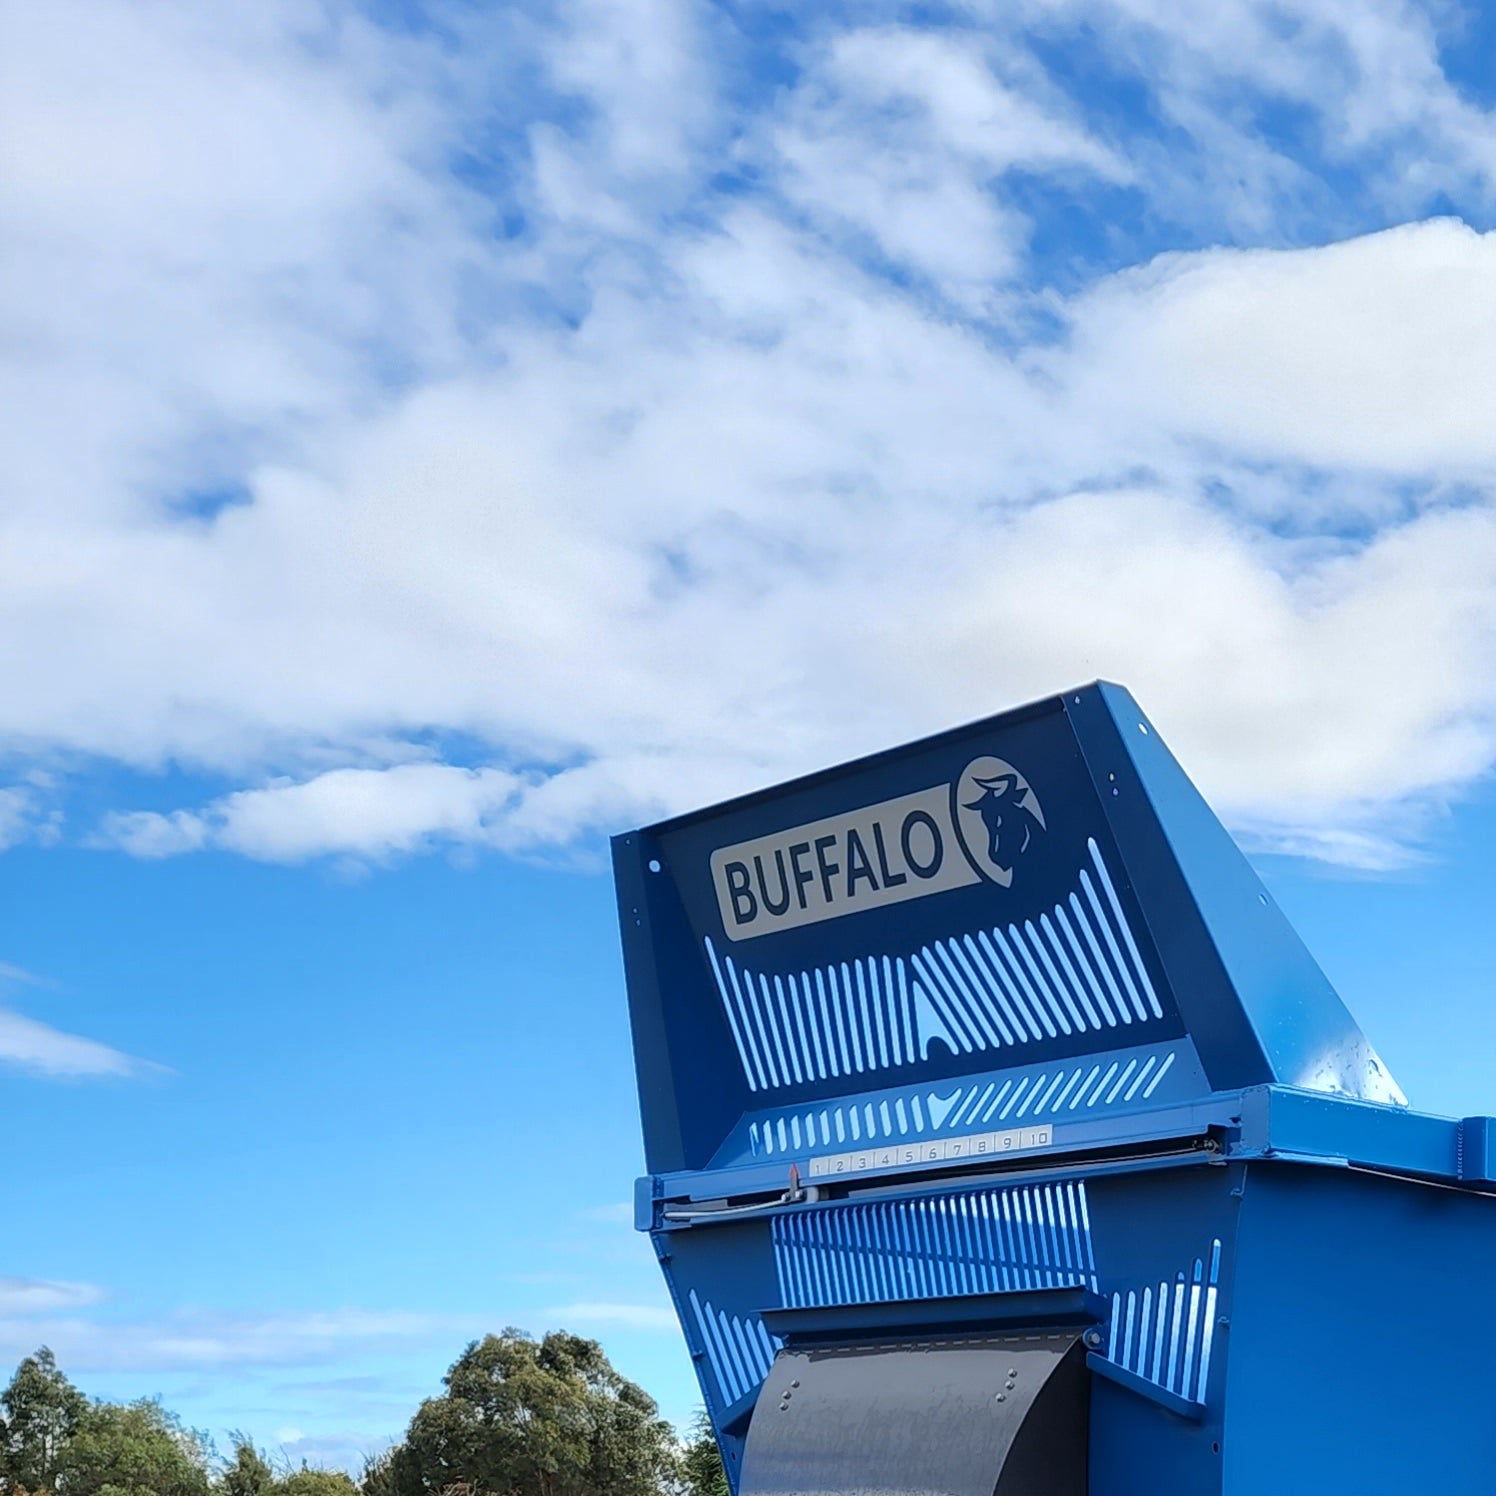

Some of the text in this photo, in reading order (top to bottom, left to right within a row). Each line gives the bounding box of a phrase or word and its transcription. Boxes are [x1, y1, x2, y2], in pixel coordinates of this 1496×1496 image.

[724, 809, 944, 926] BUFFALO
[815, 1132, 1048, 1175] 1 2 3 4 5 6 7 8 9 10
